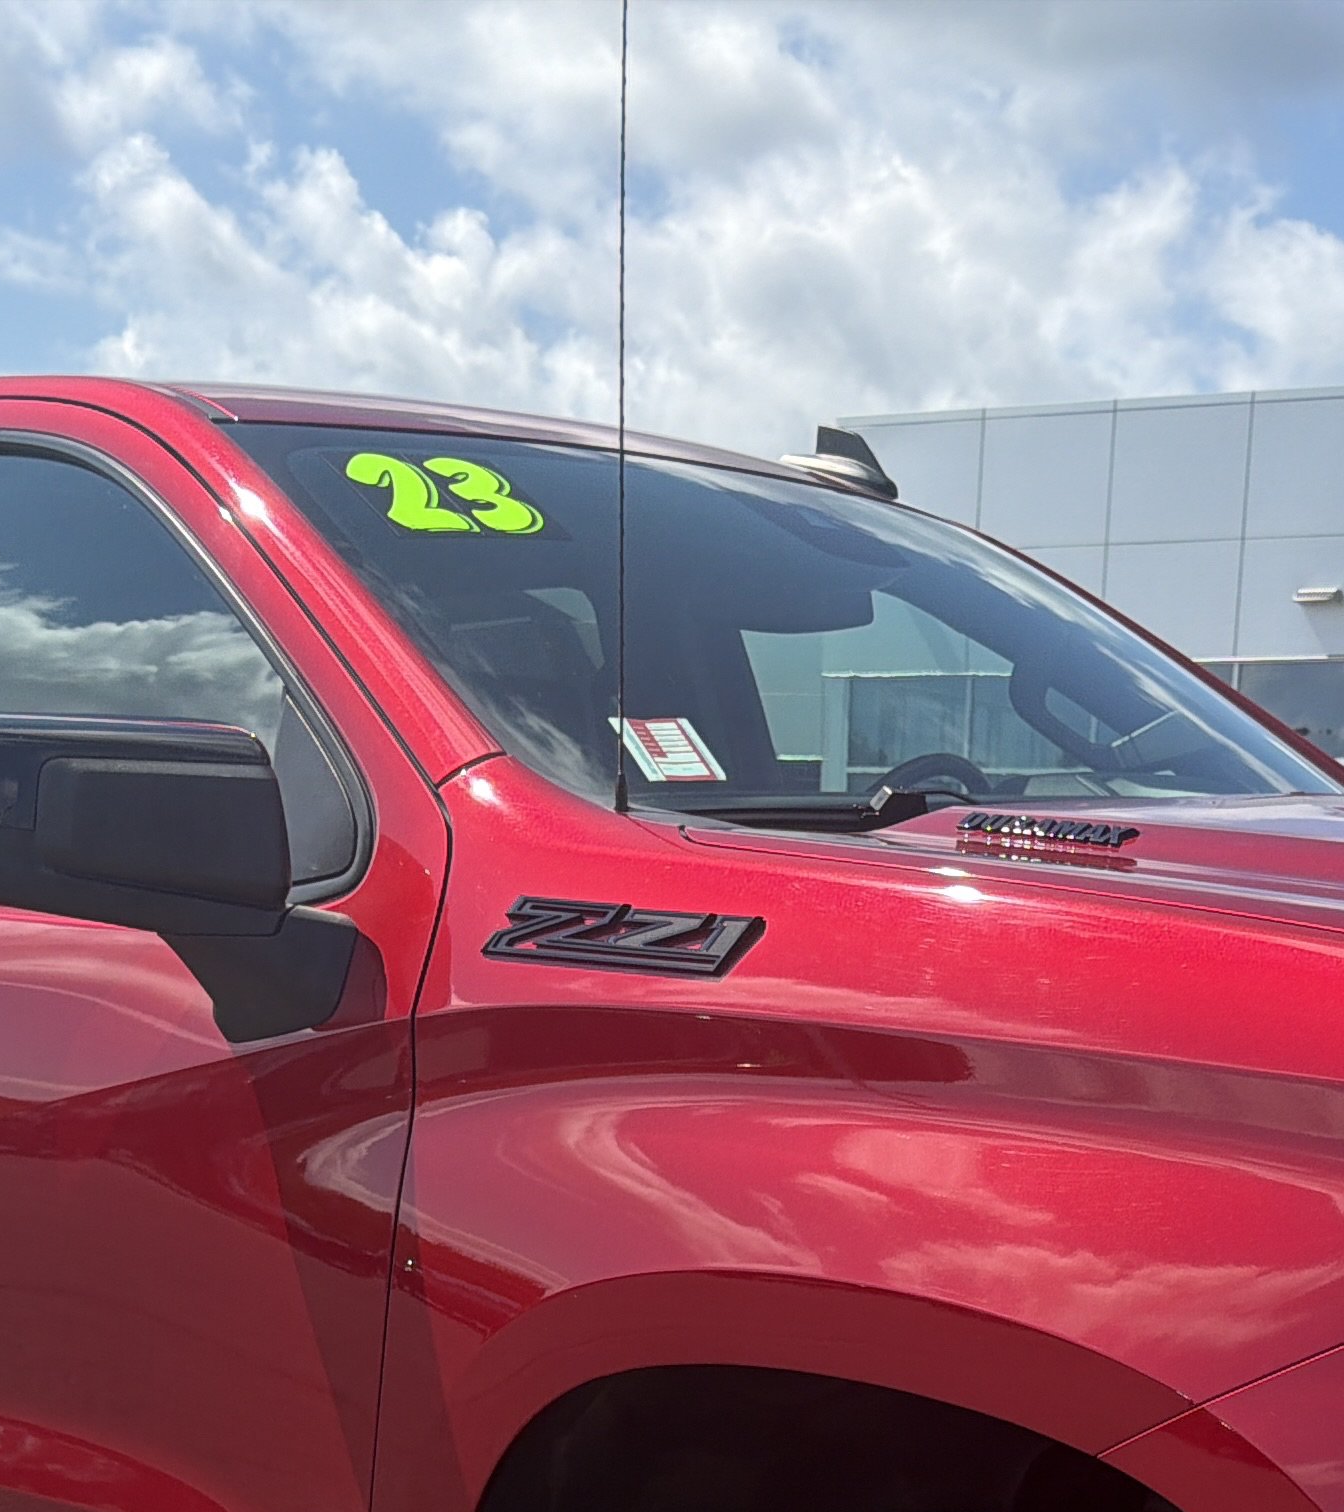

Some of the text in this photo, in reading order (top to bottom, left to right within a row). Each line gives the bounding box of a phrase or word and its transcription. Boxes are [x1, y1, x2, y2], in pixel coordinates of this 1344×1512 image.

[345, 453, 545, 534] 23
[957, 811, 1140, 848] DURAMAX
[480, 894, 767, 983] Z71
